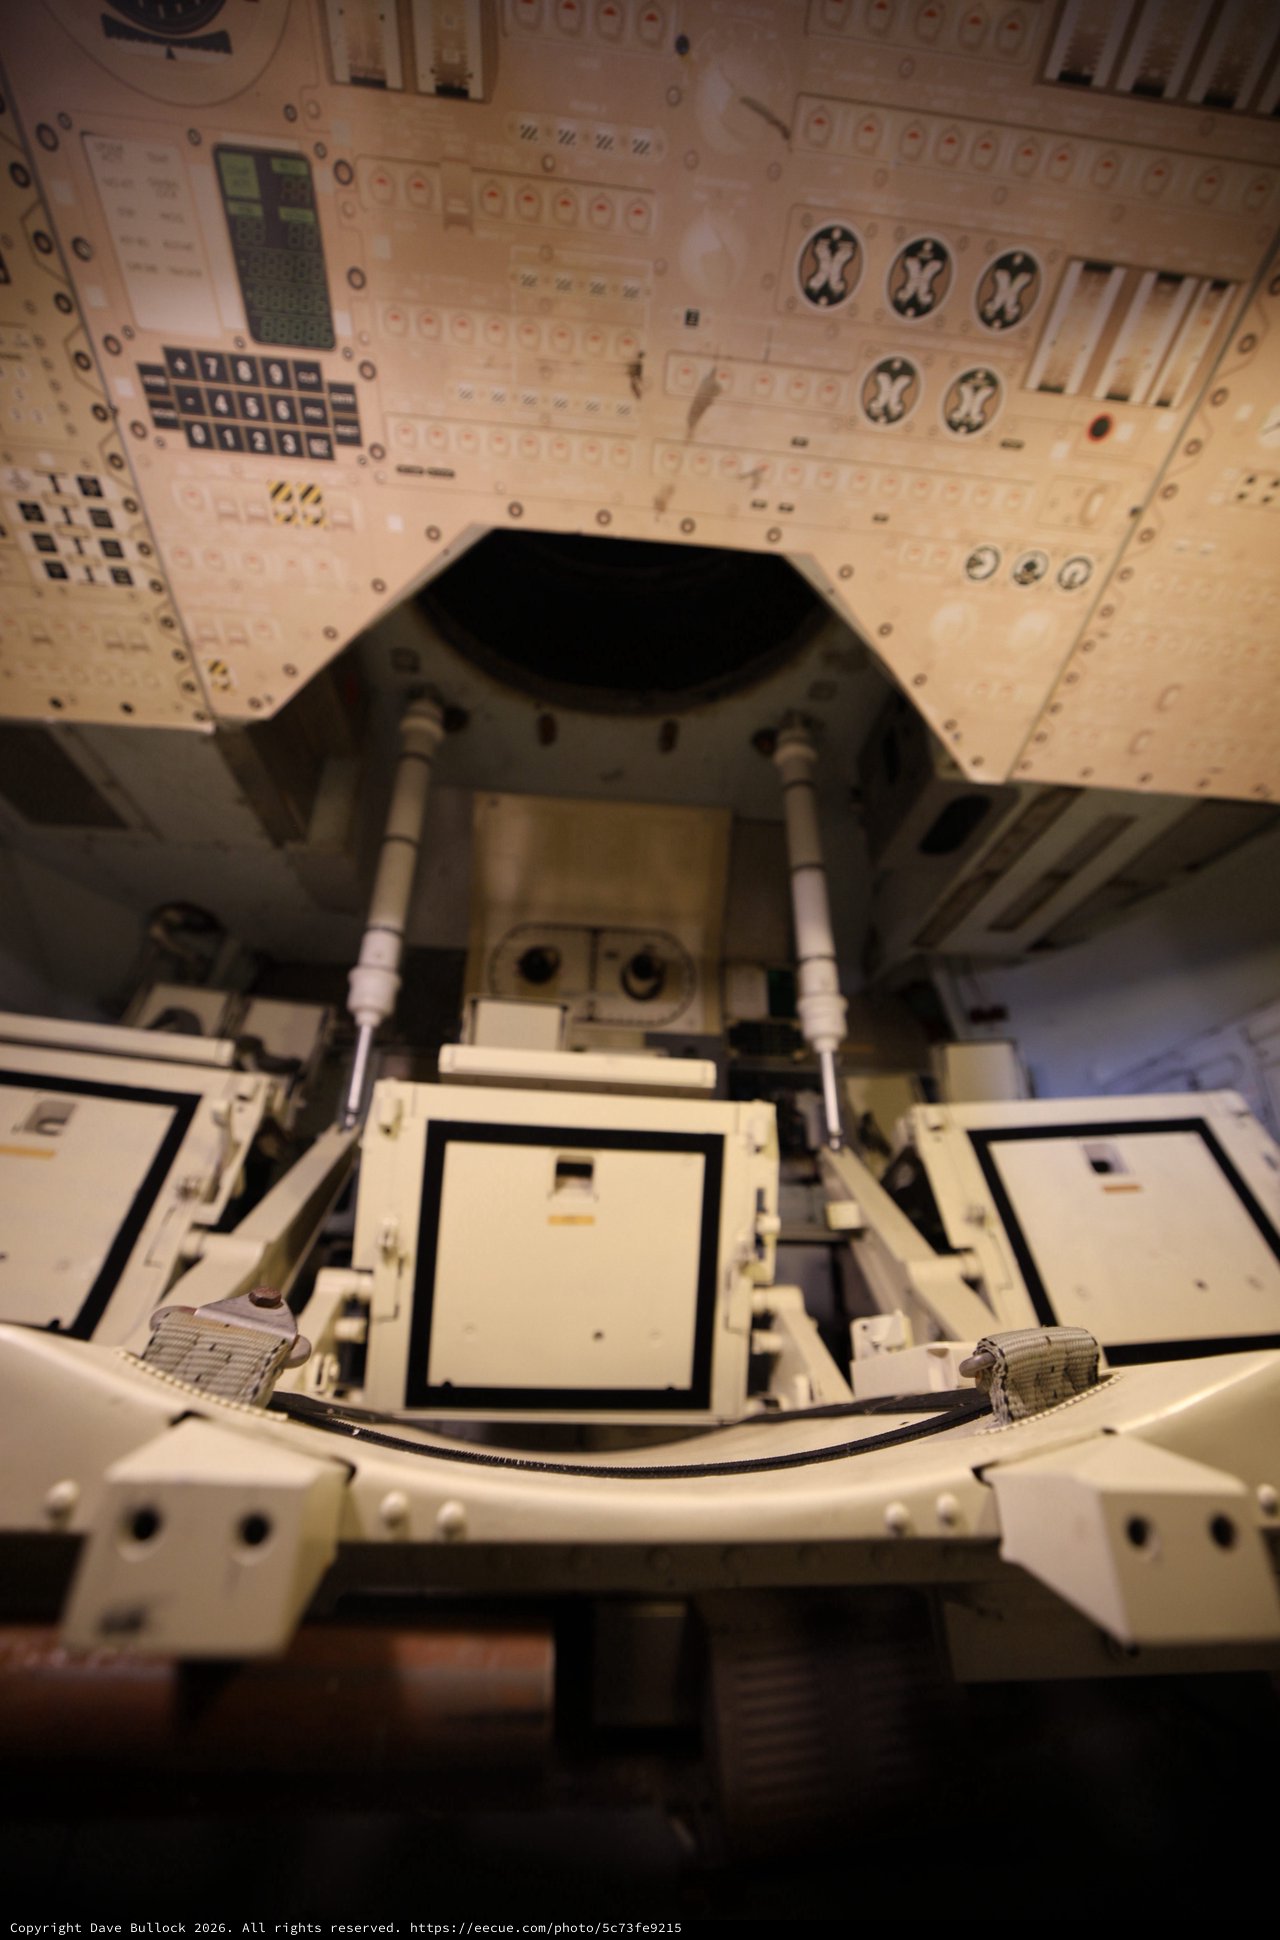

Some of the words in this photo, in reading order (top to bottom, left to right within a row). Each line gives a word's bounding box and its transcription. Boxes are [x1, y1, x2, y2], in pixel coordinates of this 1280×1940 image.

[205, 357, 217, 378] 7
[237, 360, 252, 381] 8
[269, 363, 283, 384] 9
[215, 394, 228, 414] 4
[245, 397, 260, 418] 5
[276, 399, 290, 420] 6
[191, 424, 206, 444] 0
[223, 428, 234, 448] 1
[252, 431, 267, 451] 2
[282, 434, 296, 454] 3
